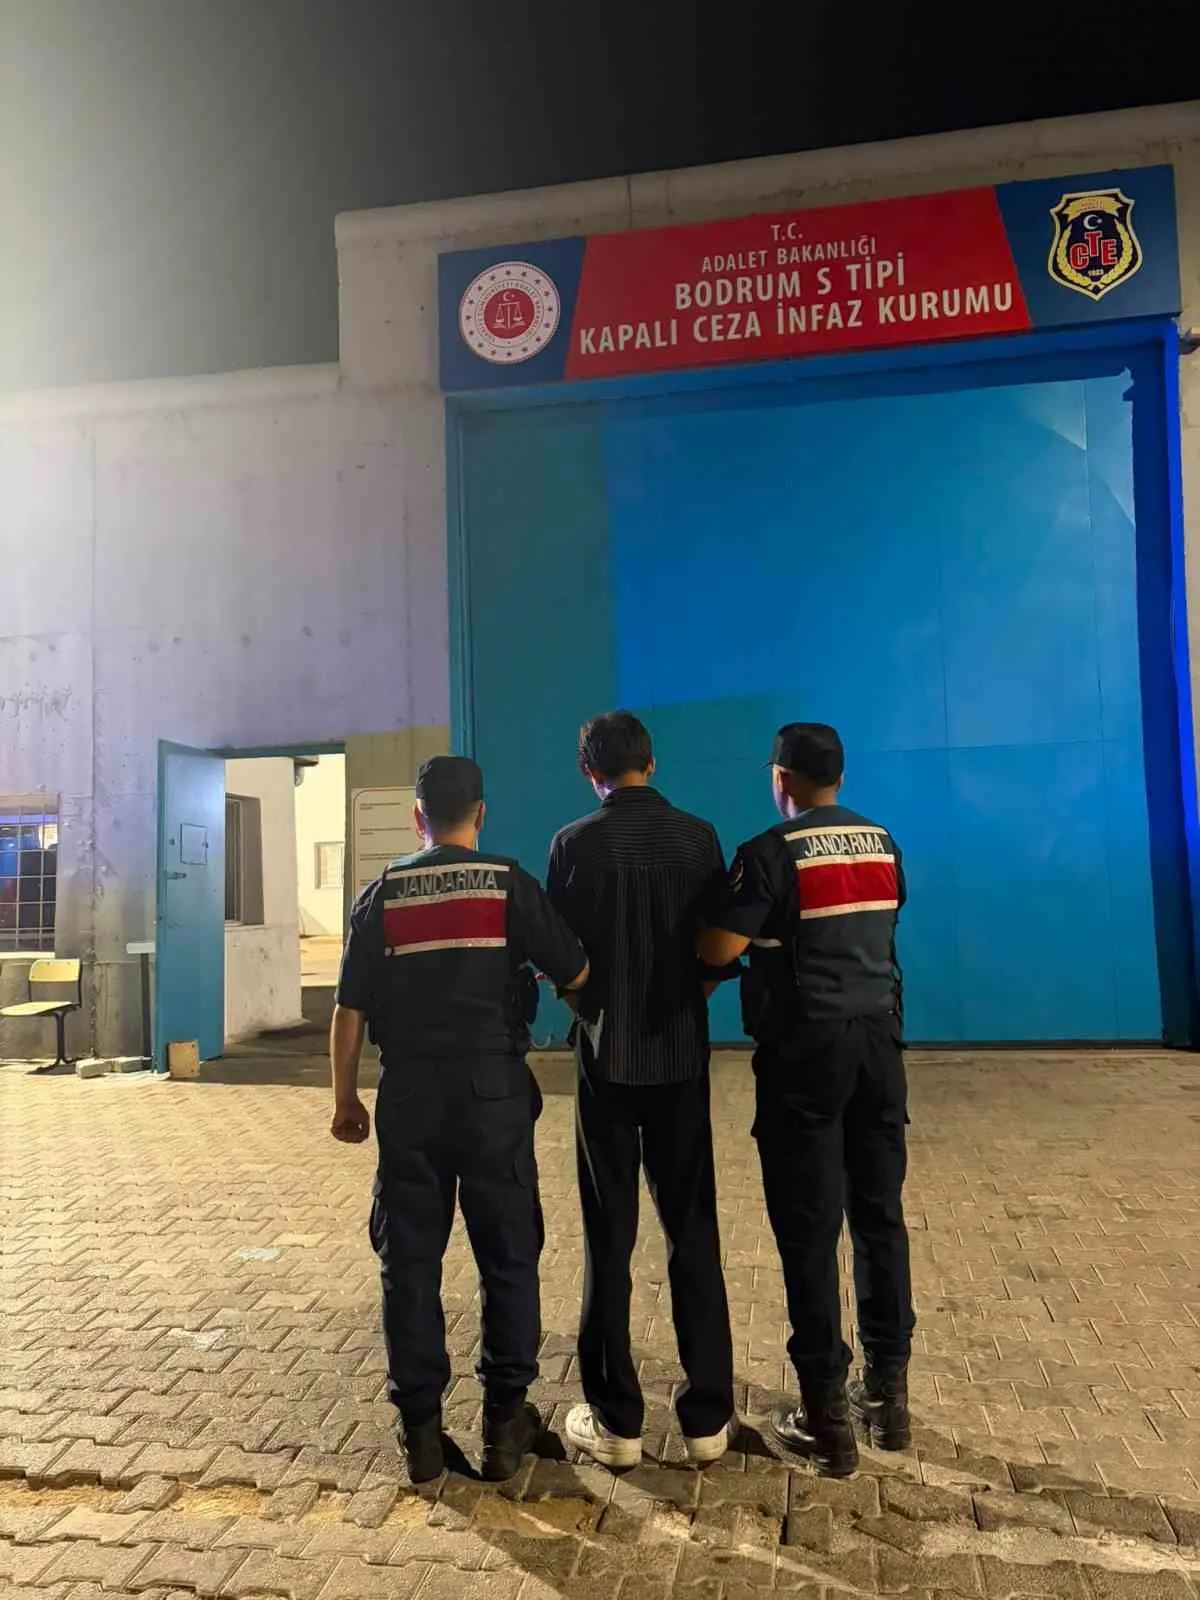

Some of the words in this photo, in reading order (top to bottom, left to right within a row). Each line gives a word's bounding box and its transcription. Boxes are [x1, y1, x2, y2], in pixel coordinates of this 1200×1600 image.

[770, 222, 803, 241] T.C.
[1070, 231, 1118, 270] CTE
[702, 250, 768, 273] ADALET
[777, 235, 876, 265] BAKANLIĞI
[675, 271, 801, 310] BODRUM
[816, 267, 832, 295] S
[846, 252, 905, 291] TİPİ
[579, 318, 678, 355] KAPALI
[692, 311, 762, 343] CEZA
[776, 300, 863, 335] İNFAZ
[878, 282, 1013, 325] KURUMU
[804, 832, 885, 857] JANDARMA
[397, 869, 498, 898] JANDARMA
